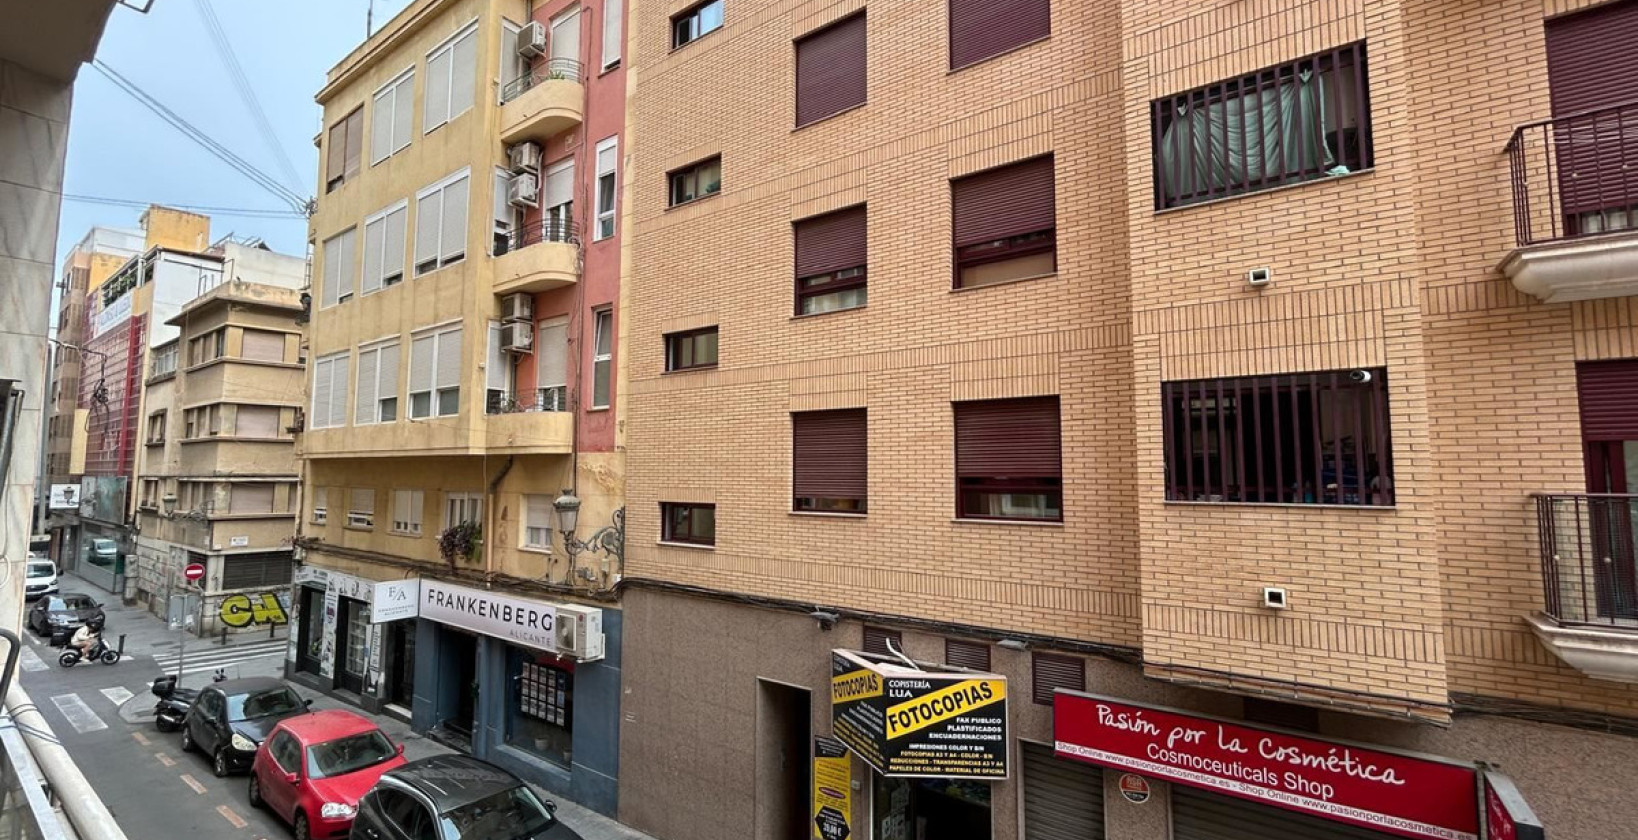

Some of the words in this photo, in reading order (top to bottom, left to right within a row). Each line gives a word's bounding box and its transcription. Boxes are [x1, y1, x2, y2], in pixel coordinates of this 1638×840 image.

[428, 588, 553, 631] FRANKENBERG
[509, 629, 551, 647] ALICANTE
[833, 673, 879, 699] FOTOCOPIAS
[888, 680, 931, 689] COPISTERÍA
[889, 689, 913, 698] LUA
[887, 681, 993, 733] FOTOCOPIAS
[1096, 704, 1161, 736] Pasión
[1167, 726, 1207, 749] por
[1258, 737, 1406, 786] Cosmética
[1057, 743, 1078, 754] Shop
[1078, 746, 1105, 758] Online
[1239, 783, 1264, 796] Shop
[1267, 789, 1299, 804] Online
[1302, 798, 1473, 840] www.pasionporlacosmetica.es
[1147, 743, 1279, 787] Cosmoceuticals
[1283, 771, 1334, 801] Shop
